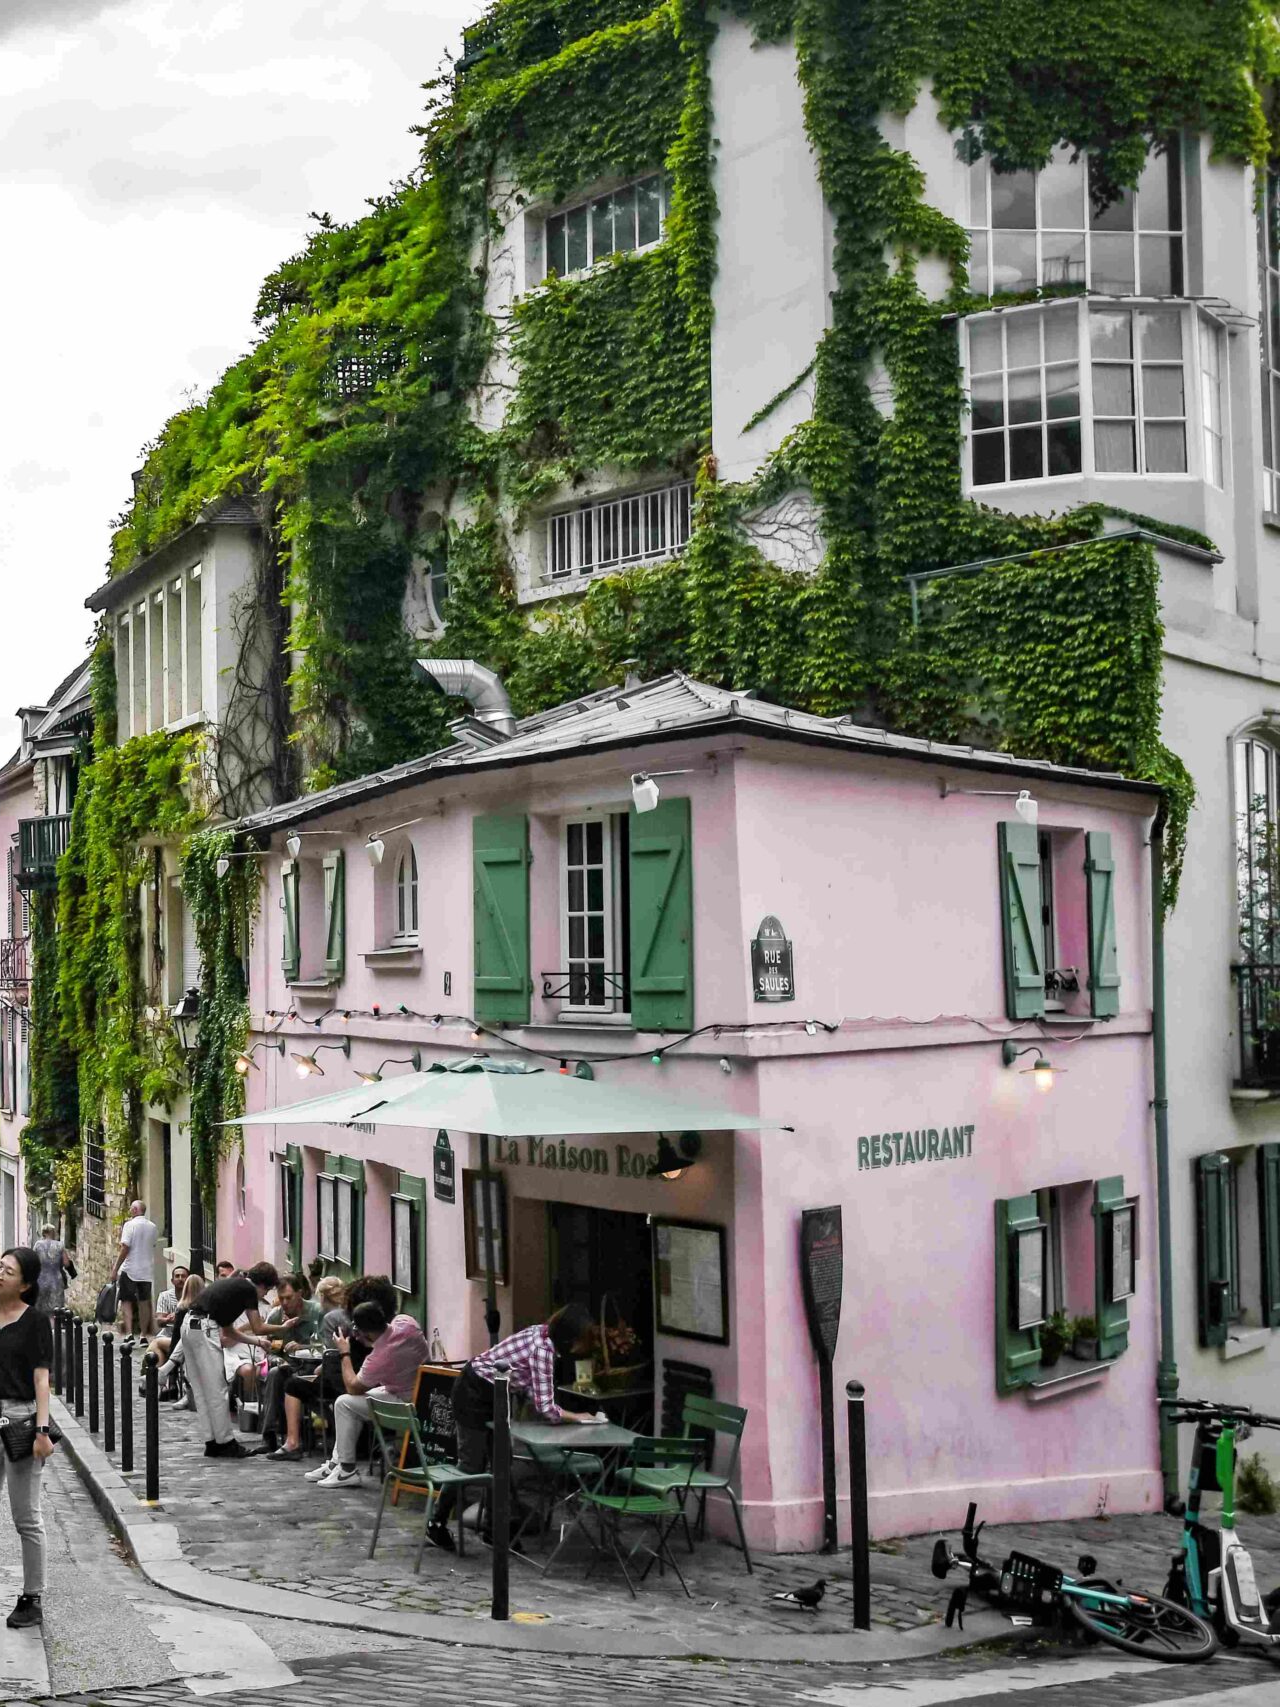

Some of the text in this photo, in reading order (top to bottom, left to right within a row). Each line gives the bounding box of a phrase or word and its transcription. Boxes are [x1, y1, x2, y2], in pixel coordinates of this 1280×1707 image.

[764, 950, 781, 964] RUE
[768, 966, 778, 975] DES
[759, 977, 789, 991] SAULES
[857, 1125, 974, 1171] RESTAURANT
[495, 1135, 659, 1180] La Maison Ros
